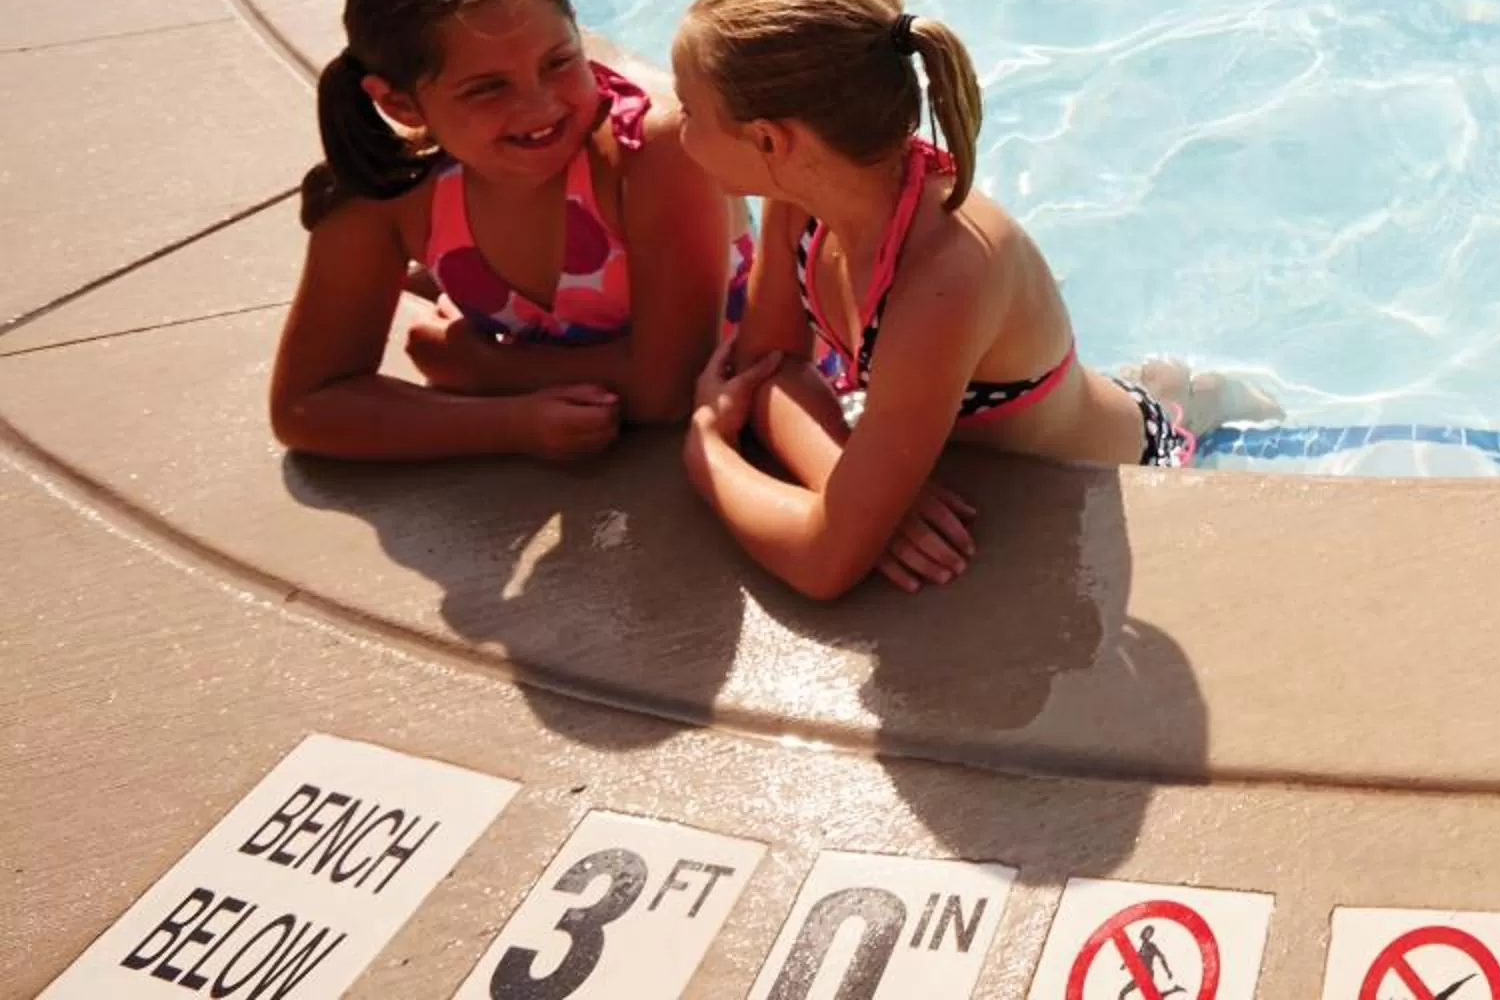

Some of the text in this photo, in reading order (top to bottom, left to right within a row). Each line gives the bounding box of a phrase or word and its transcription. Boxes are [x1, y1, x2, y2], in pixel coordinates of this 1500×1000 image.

[239, 783, 440, 895] BENCH
[119, 887, 348, 1000] BELOW
[489, 848, 735, 1000] 3 FT
[909, 892, 988, 953] IN
